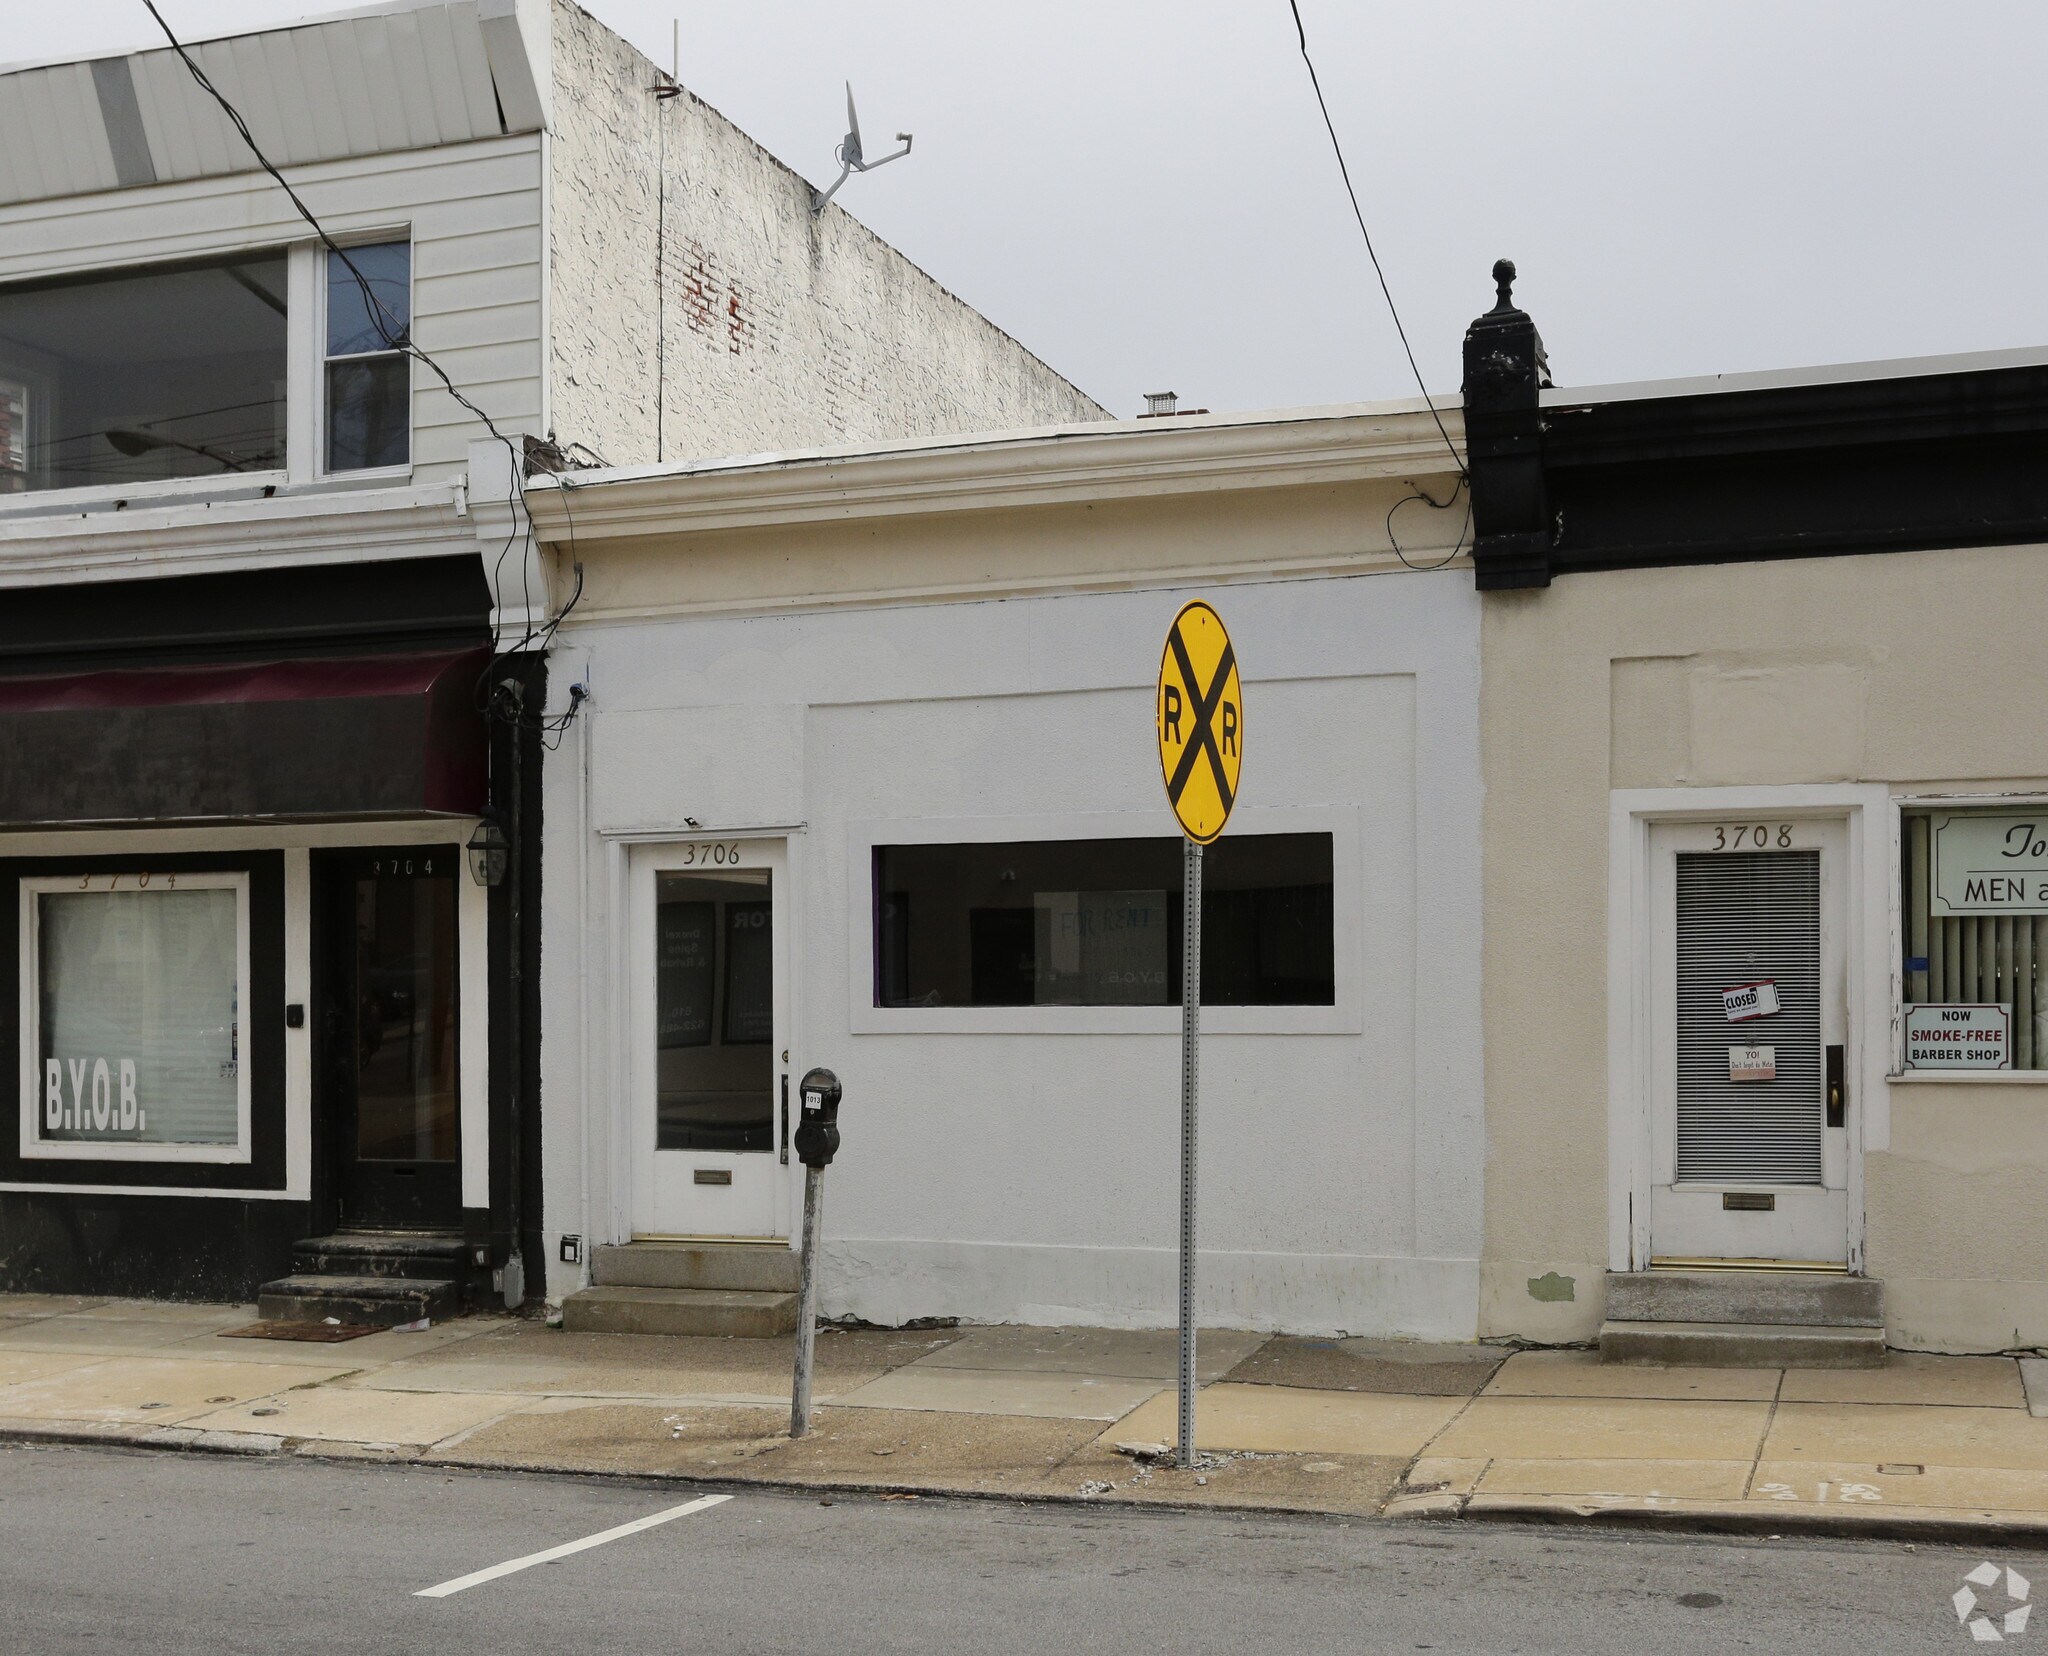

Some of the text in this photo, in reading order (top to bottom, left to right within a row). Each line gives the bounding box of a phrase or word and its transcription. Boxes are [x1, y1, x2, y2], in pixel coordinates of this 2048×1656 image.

[1712, 824, 1793, 851] 3708
[2001, 824, 2048, 857] To
[683, 843, 740, 865] 3706
[373, 860, 432, 875] 3704
[79, 872, 176, 890] 3704
[1964, 878, 2024, 902] MEN
[1725, 992, 1757, 1009] CLOSED
[1942, 1011, 1971, 1021] NOW
[1911, 1030, 2002, 1041] SMOKE-FREE
[1912, 1049, 2001, 1060] BARBER SHOP
[46, 1057, 145, 1131] B.Y.O.B.
[807, 1096, 821, 1104] 1013
